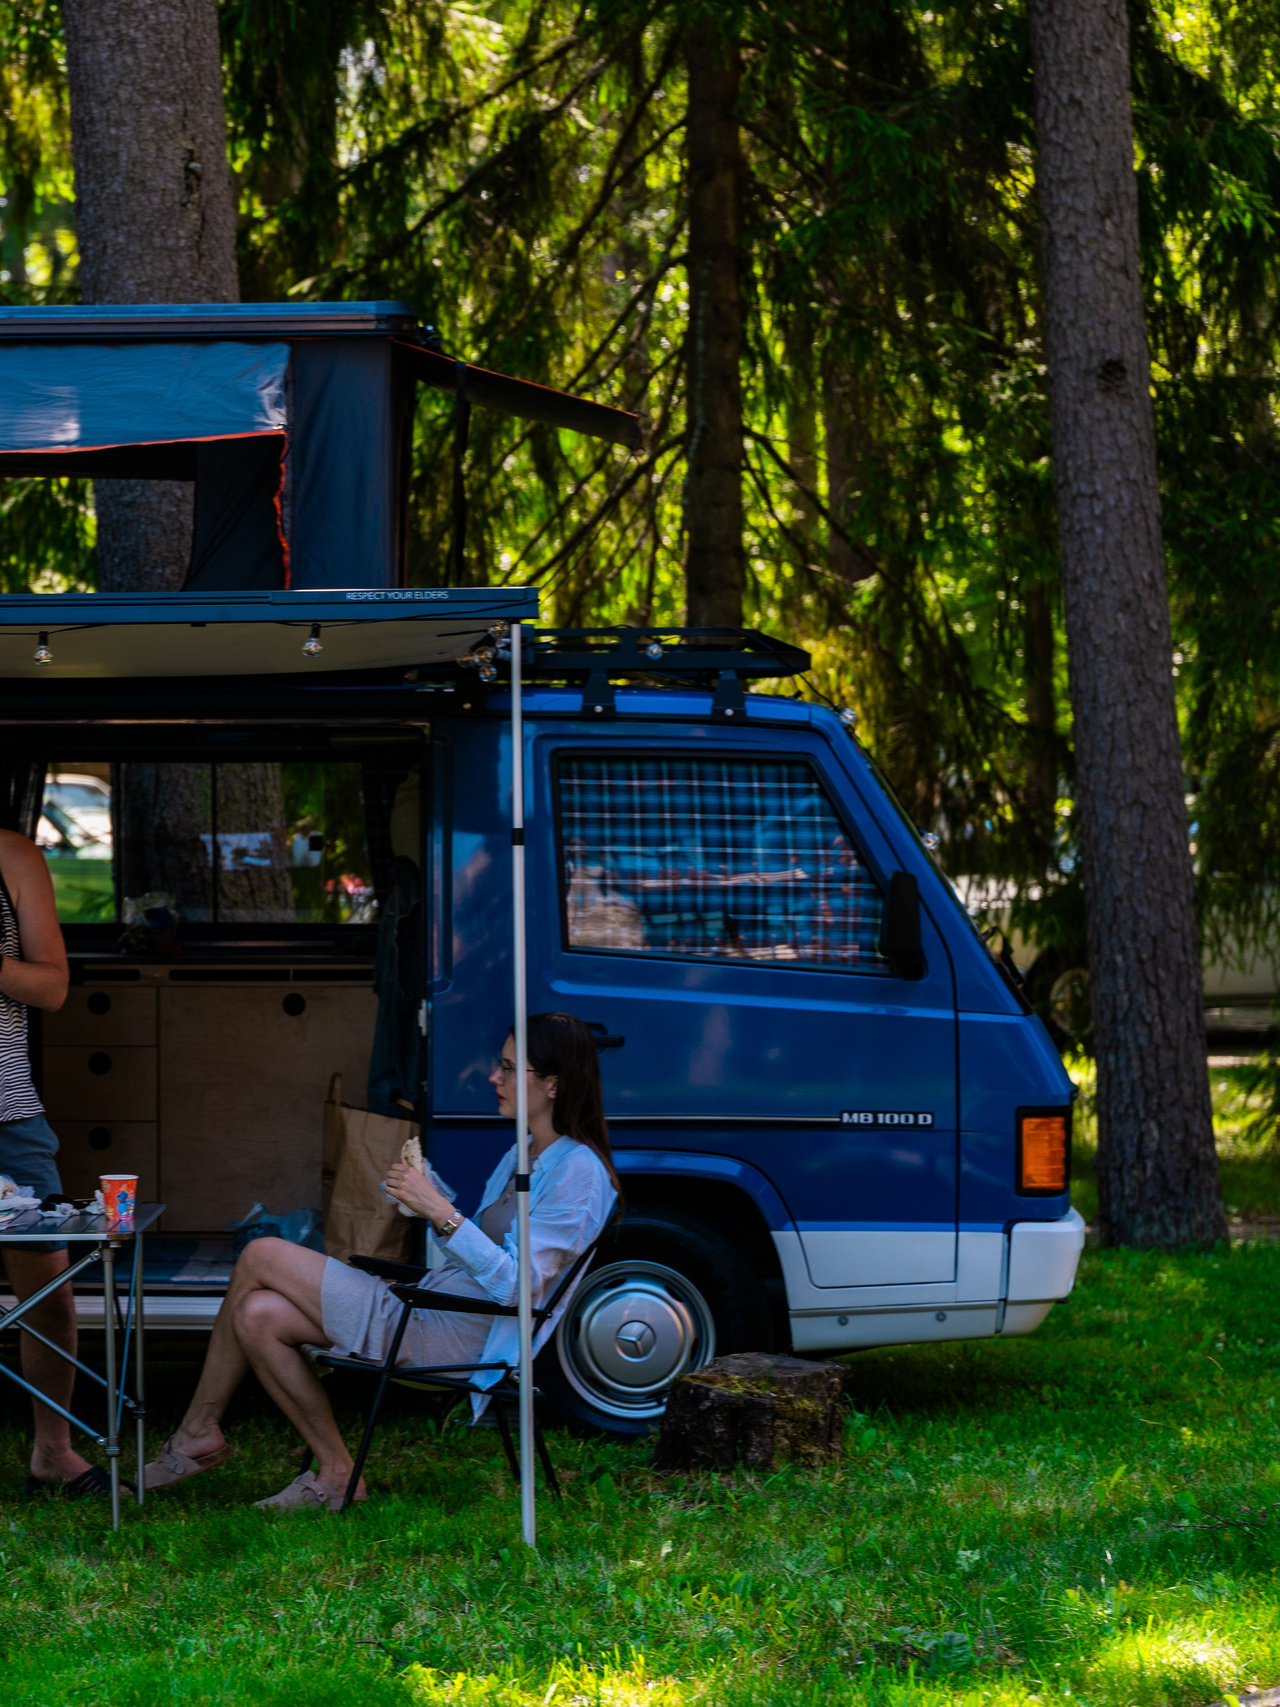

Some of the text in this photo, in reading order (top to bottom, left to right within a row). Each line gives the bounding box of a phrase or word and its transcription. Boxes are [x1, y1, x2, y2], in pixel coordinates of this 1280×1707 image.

[346, 591, 449, 600] RESPECT YOUR ELDERS
[842, 1112, 932, 1125] MB 100 D
